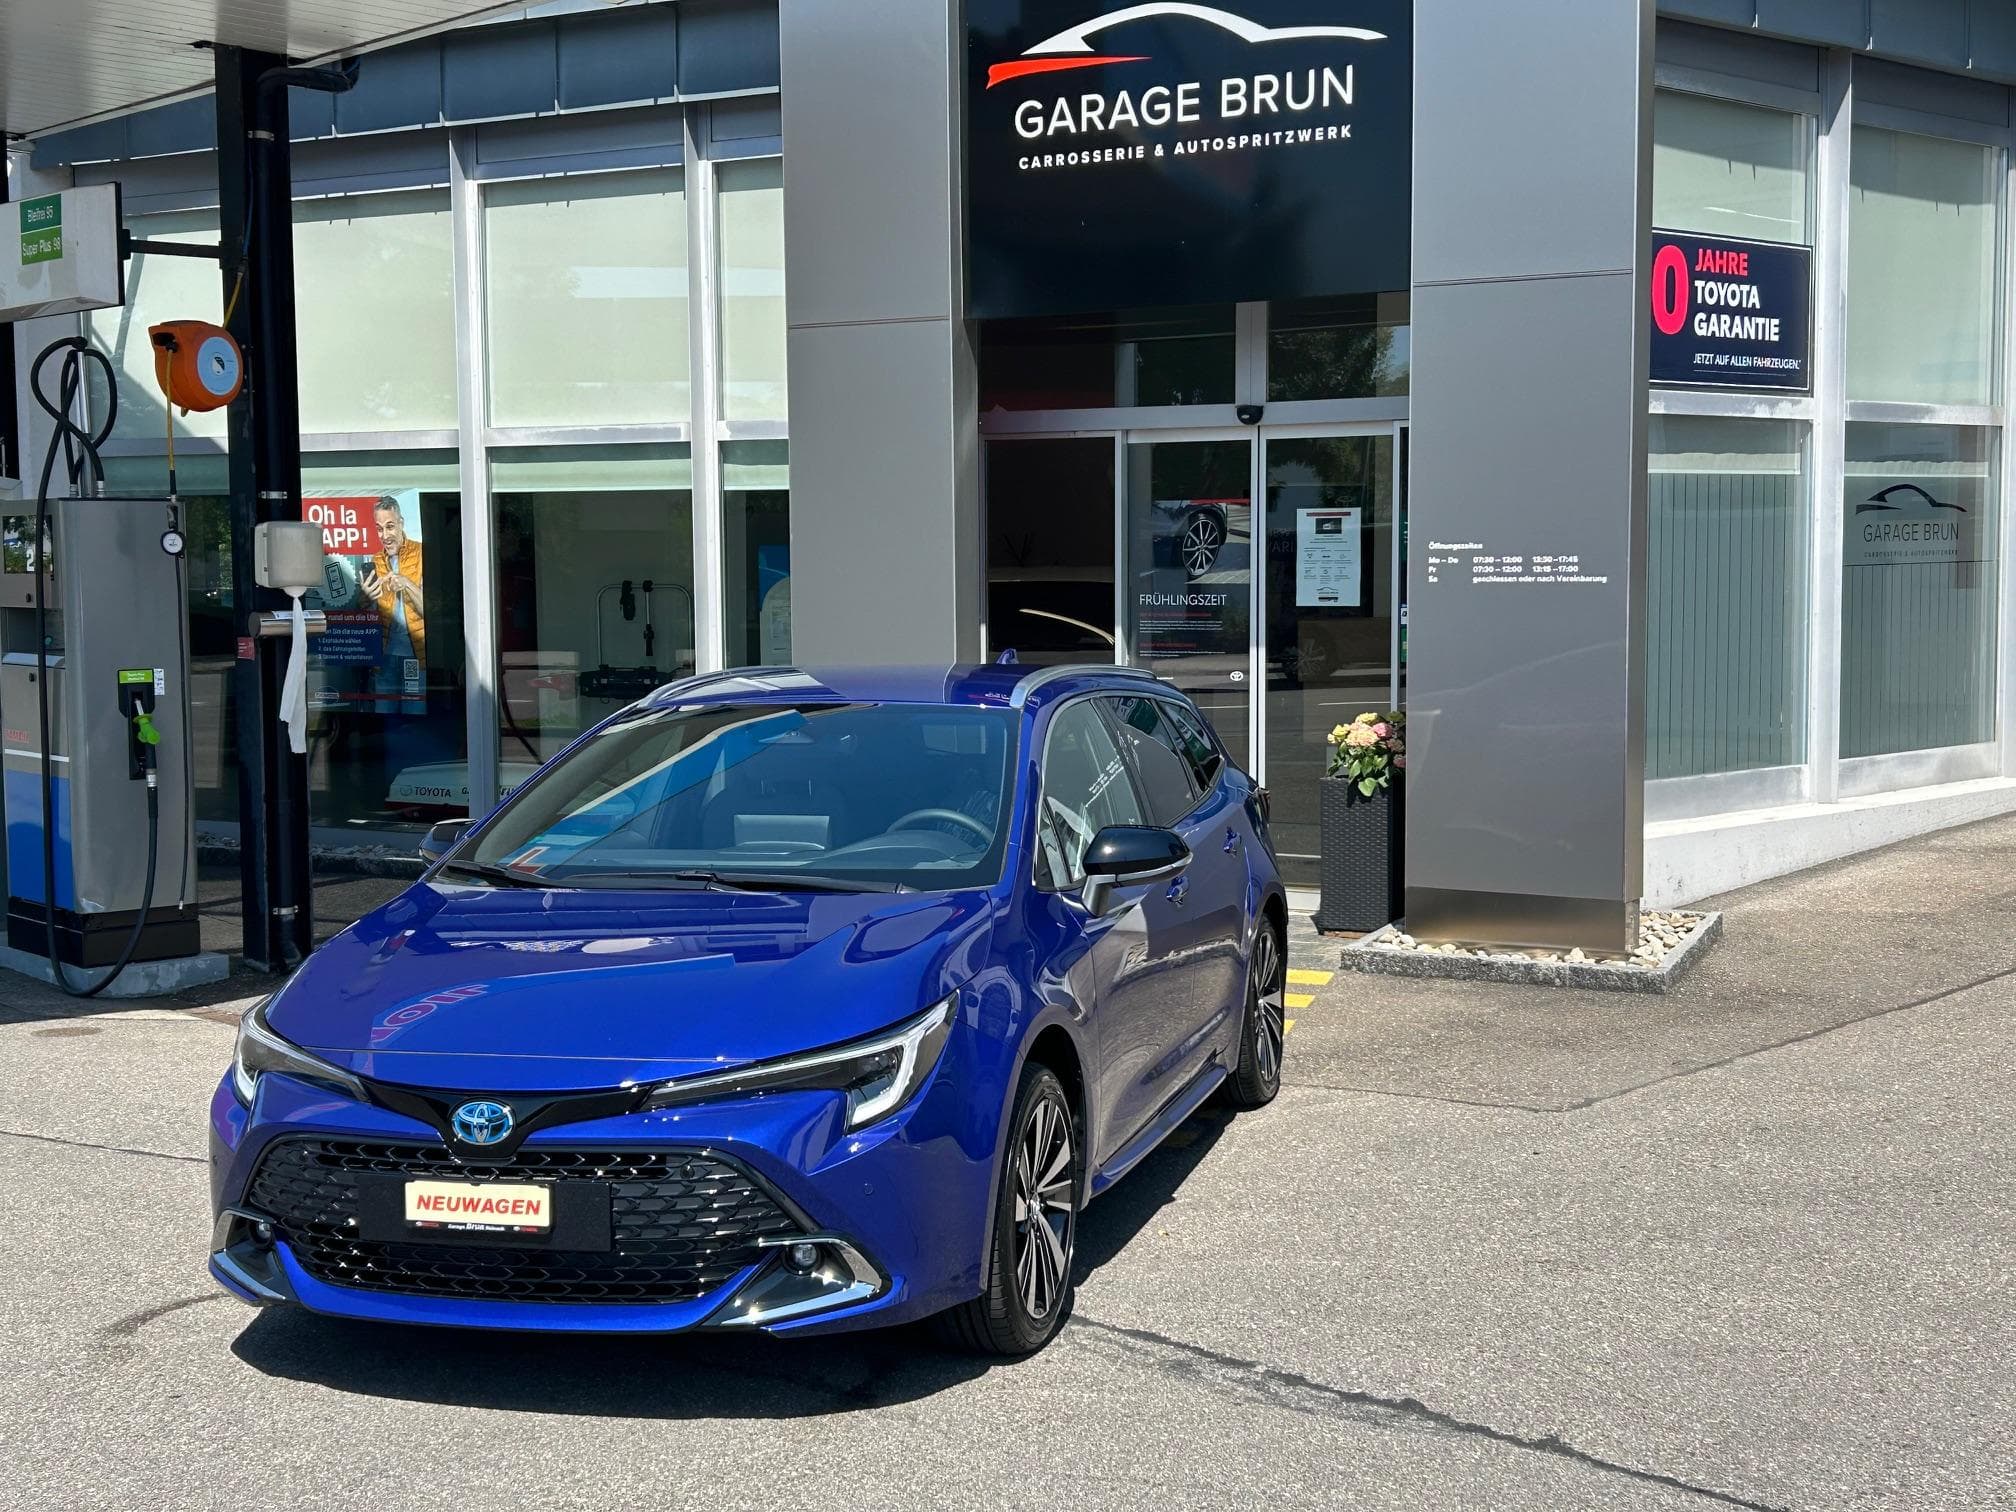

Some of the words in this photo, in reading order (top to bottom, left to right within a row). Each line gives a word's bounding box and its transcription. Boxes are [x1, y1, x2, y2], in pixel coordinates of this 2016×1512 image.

[1014, 82, 1200, 138] GARAGE
[1221, 64, 1353, 118] BRUN
[1018, 145, 1145, 170] CARROSSERIE
[1154, 143, 1164, 157] &
[1173, 124, 1352, 155] AUTOSPRITZWERK
[39, 239, 52, 252] Plus
[1695, 248, 1748, 276] JAHRE
[1694, 280, 1761, 309] TOYOTA
[1693, 312, 1780, 341] GARANTIE
[1693, 353, 1714, 364] JETZT
[1714, 354, 1729, 366] AUF
[1730, 355, 1752, 367] ALLEN
[308, 504, 335, 525] Oh
[340, 505, 357, 525] la
[1863, 523, 1919, 542] GARAGE
[1923, 522, 1959, 541] BRUN
[1428, 541, 1483, 551] Öffnungszeiten
[26, 549, 35, 571] 2
[1428, 556, 1440, 564] Mo
[1448, 556, 1459, 564] Do
[1472, 556, 1494, 564] 07:30
[1502, 556, 1523, 564] 12:00
[1428, 565, 1437, 573] Fr
[1472, 575, 1518, 584] geschlossen
[1518, 575, 1535, 583] oder
[1536, 575, 1555, 583] nach
[1556, 575, 1608, 584] Vereinbarung
[1139, 591, 1227, 606] FRÜHLINGSZEIT
[414, 786, 452, 798] TOYOTA
[416, 1195, 541, 1216] NEUWAGEN
